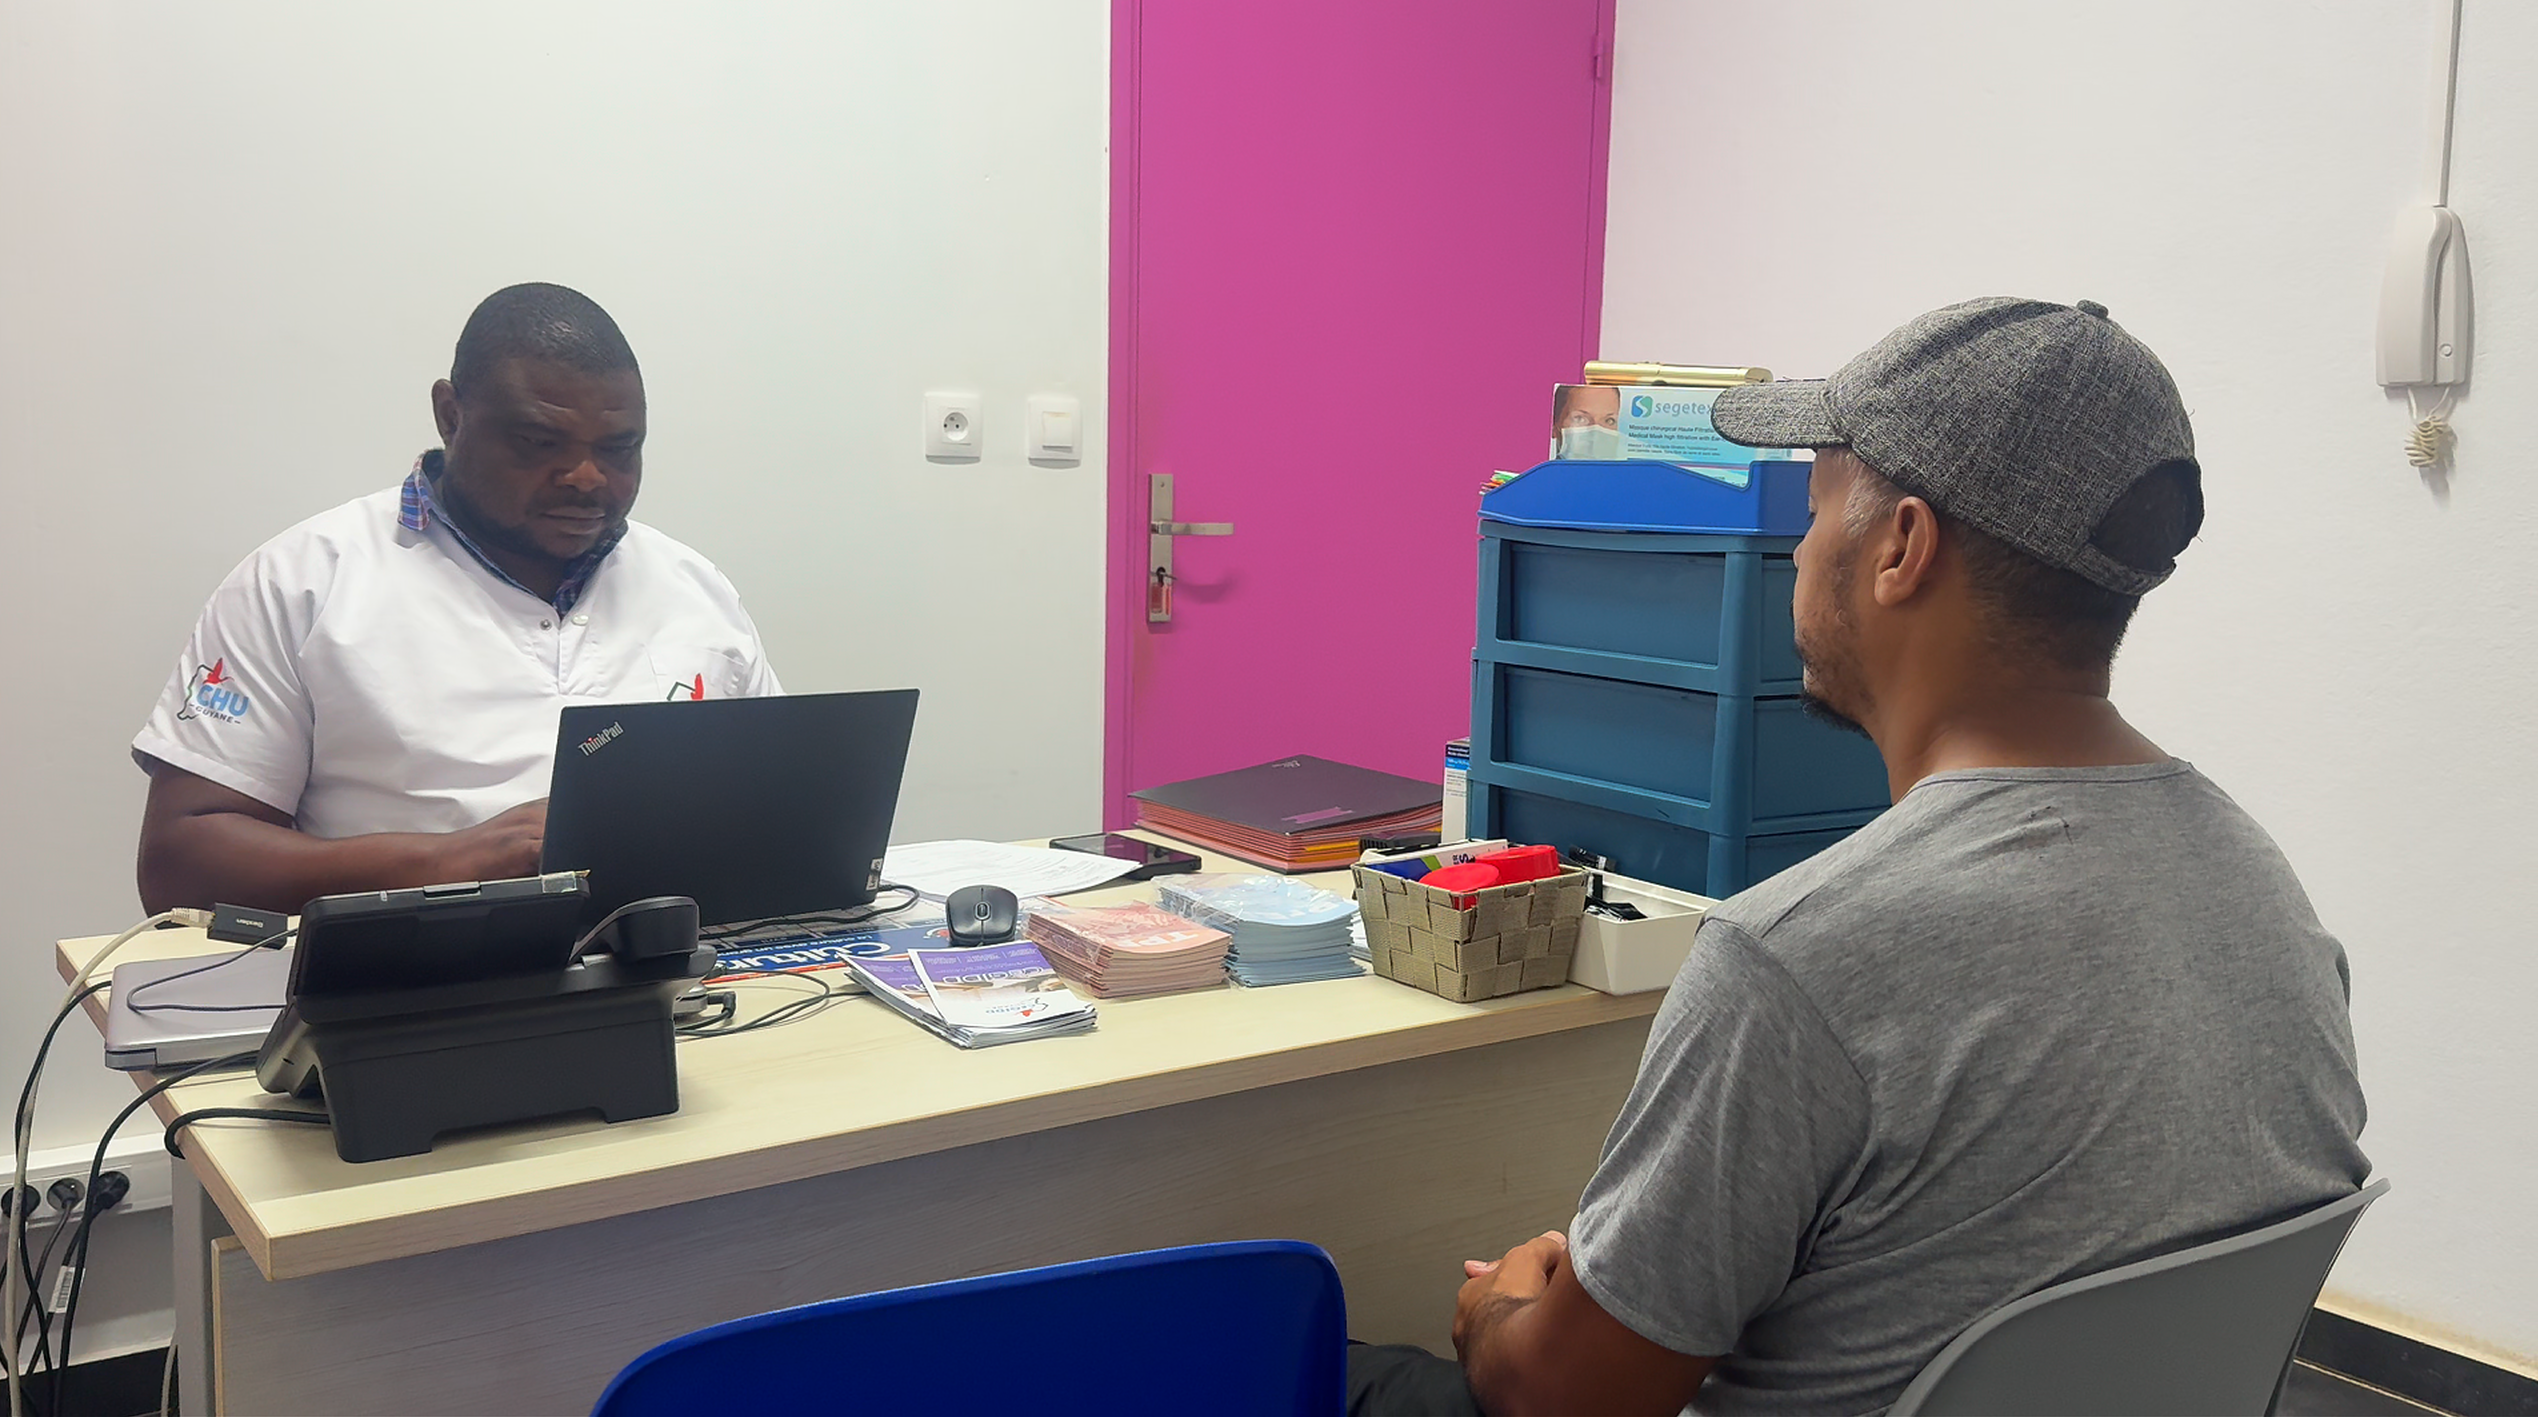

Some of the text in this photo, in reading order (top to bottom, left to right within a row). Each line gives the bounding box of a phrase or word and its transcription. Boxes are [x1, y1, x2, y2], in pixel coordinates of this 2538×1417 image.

[1664, 433, 1675, 441] high
[196, 684, 250, 717] CHU
[195, 705, 234, 723] GUYANE
[578, 721, 624, 757] ThinkPad
